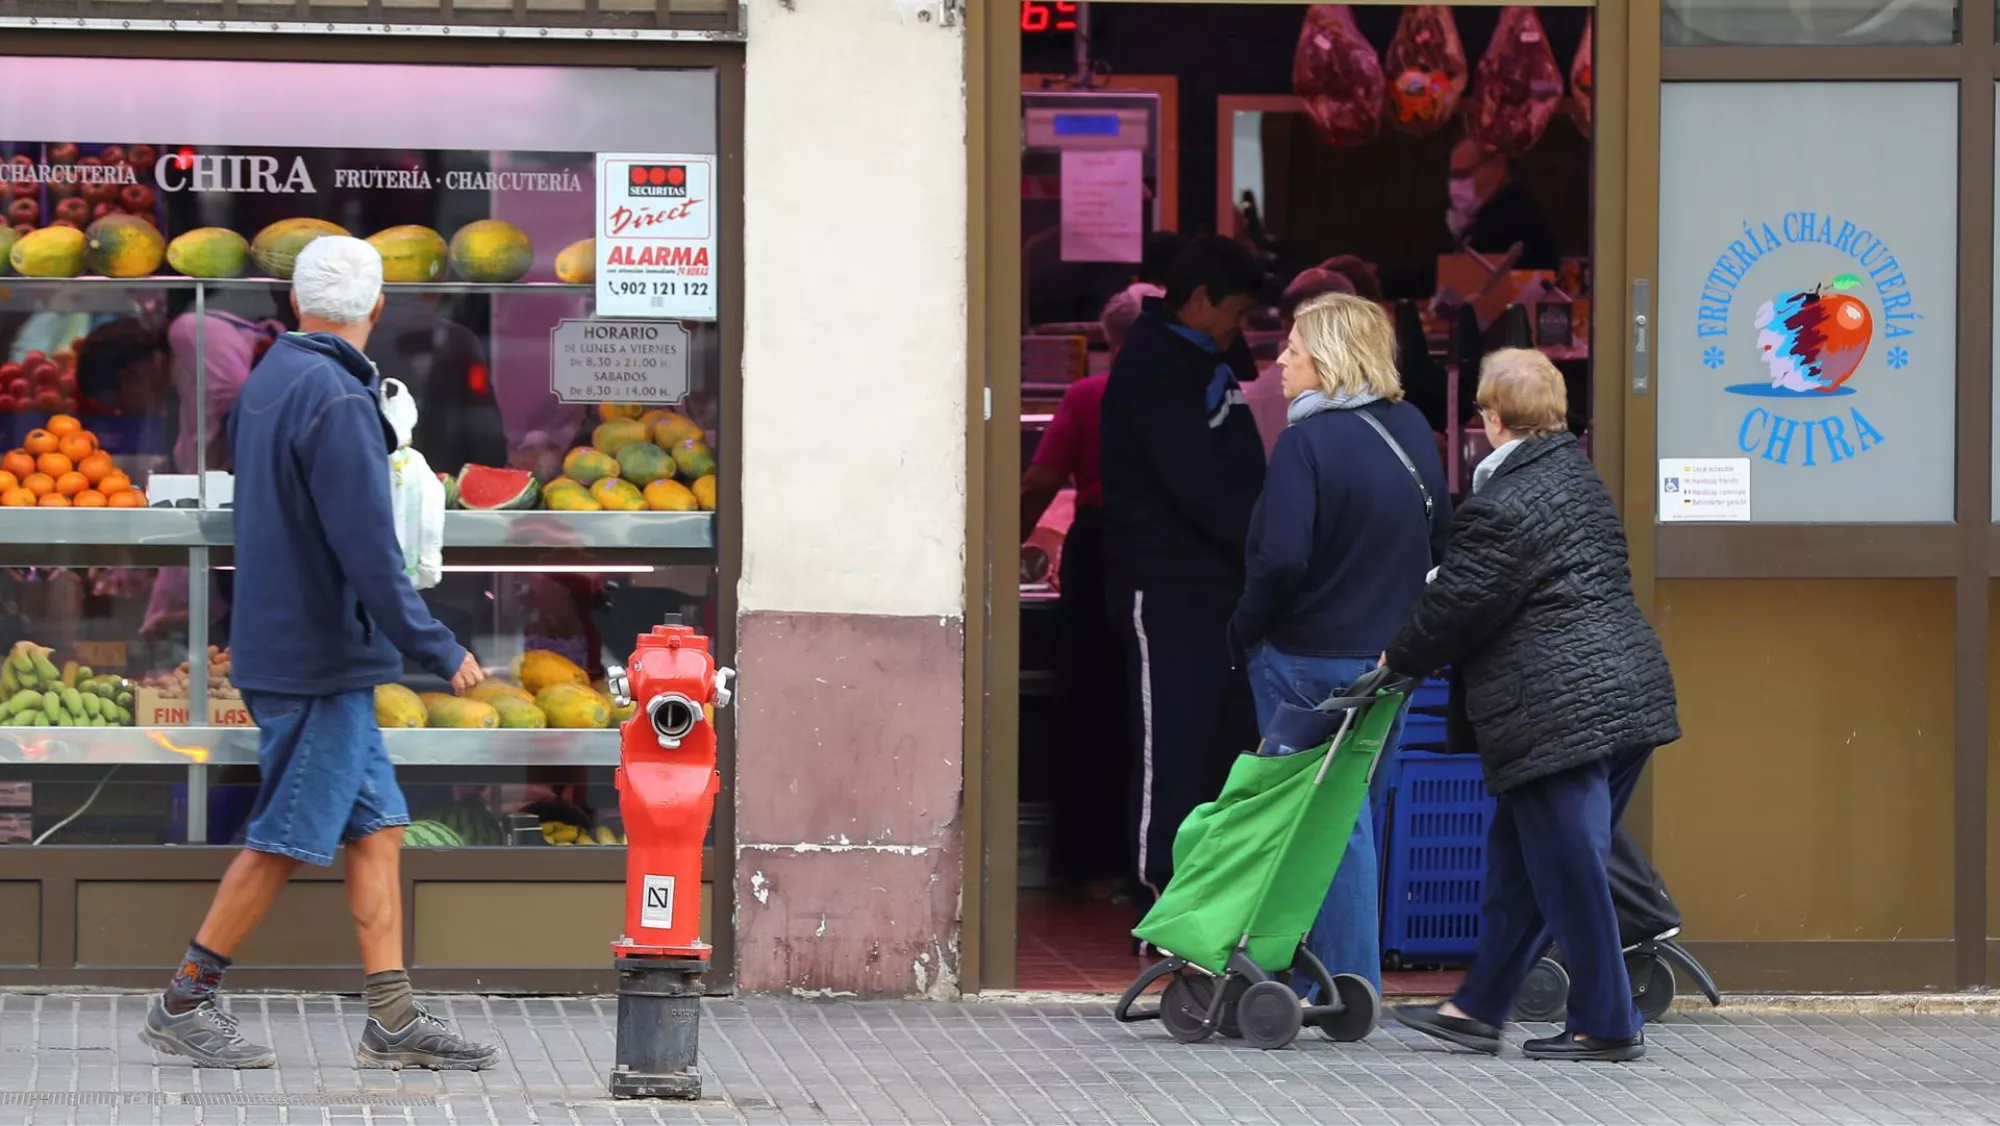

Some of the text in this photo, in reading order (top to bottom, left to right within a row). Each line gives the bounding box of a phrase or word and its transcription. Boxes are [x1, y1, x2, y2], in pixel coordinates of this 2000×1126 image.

[0, 153, 582, 194] CHARCUTERÍA CHIRA FRUTERÍA CHARCUTERÍA
[629, 186, 686, 196] SECURITAS
[609, 197, 705, 235] Direct
[606, 245, 709, 267] ALARMA
[1696, 211, 1925, 339] FRUTERÍA CHARCUTERÍA
[620, 281, 708, 296] 902 121 122
[584, 326, 659, 340] HORARIO
[564, 343, 677, 355] DE LUNES A VIERNES
[593, 371, 648, 382] SABADOS
[625, 386, 657, 398] 14,00
[1738, 405, 1886, 467] CHIRA
[154, 708, 248, 724] FIN LAS
